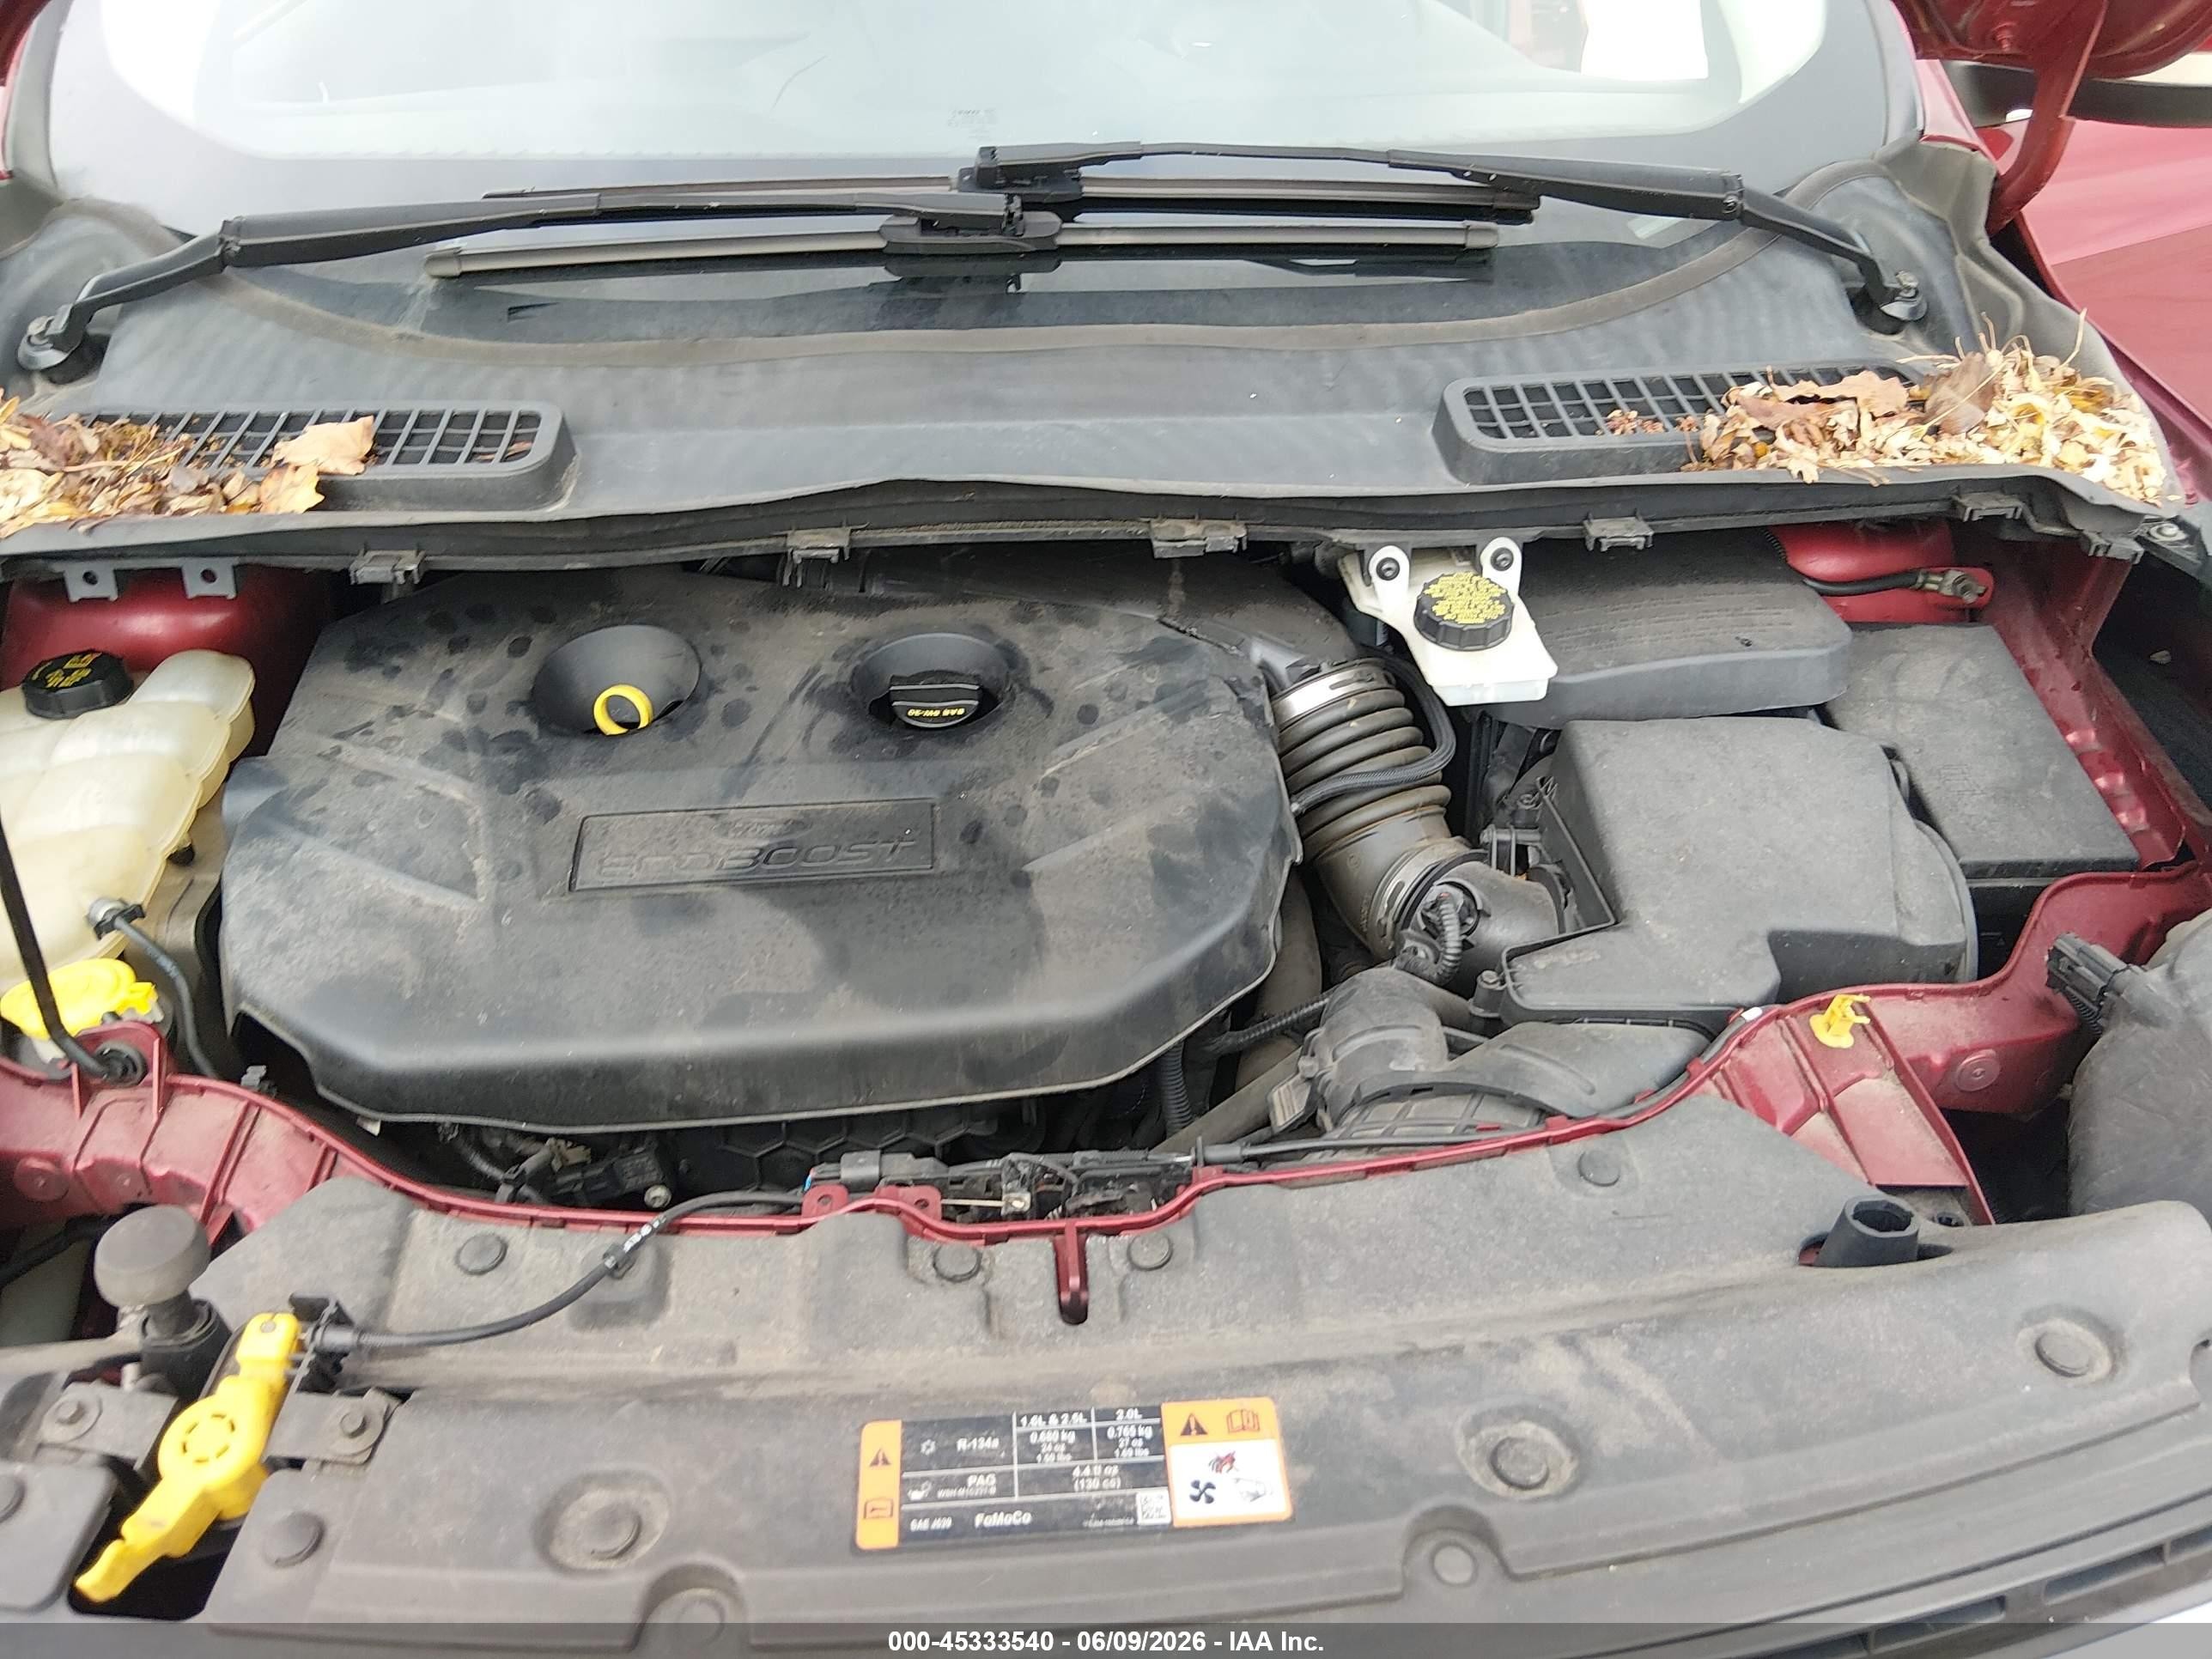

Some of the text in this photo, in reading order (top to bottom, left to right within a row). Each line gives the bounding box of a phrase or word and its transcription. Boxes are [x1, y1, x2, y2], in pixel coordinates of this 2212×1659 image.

[1048, 1413, 1059, 1425] &
[1115, 1407, 1142, 1420] 2.0L
[1060, 1429, 1075, 1444] kg
[1138, 1424, 1152, 1439] kg
[1118, 1437, 1130, 1449] 27
[1134, 1447, 1149, 1457] lbs
[967, 1473, 996, 1487] PAG
[975, 1510, 1032, 1528] FoMoCo
